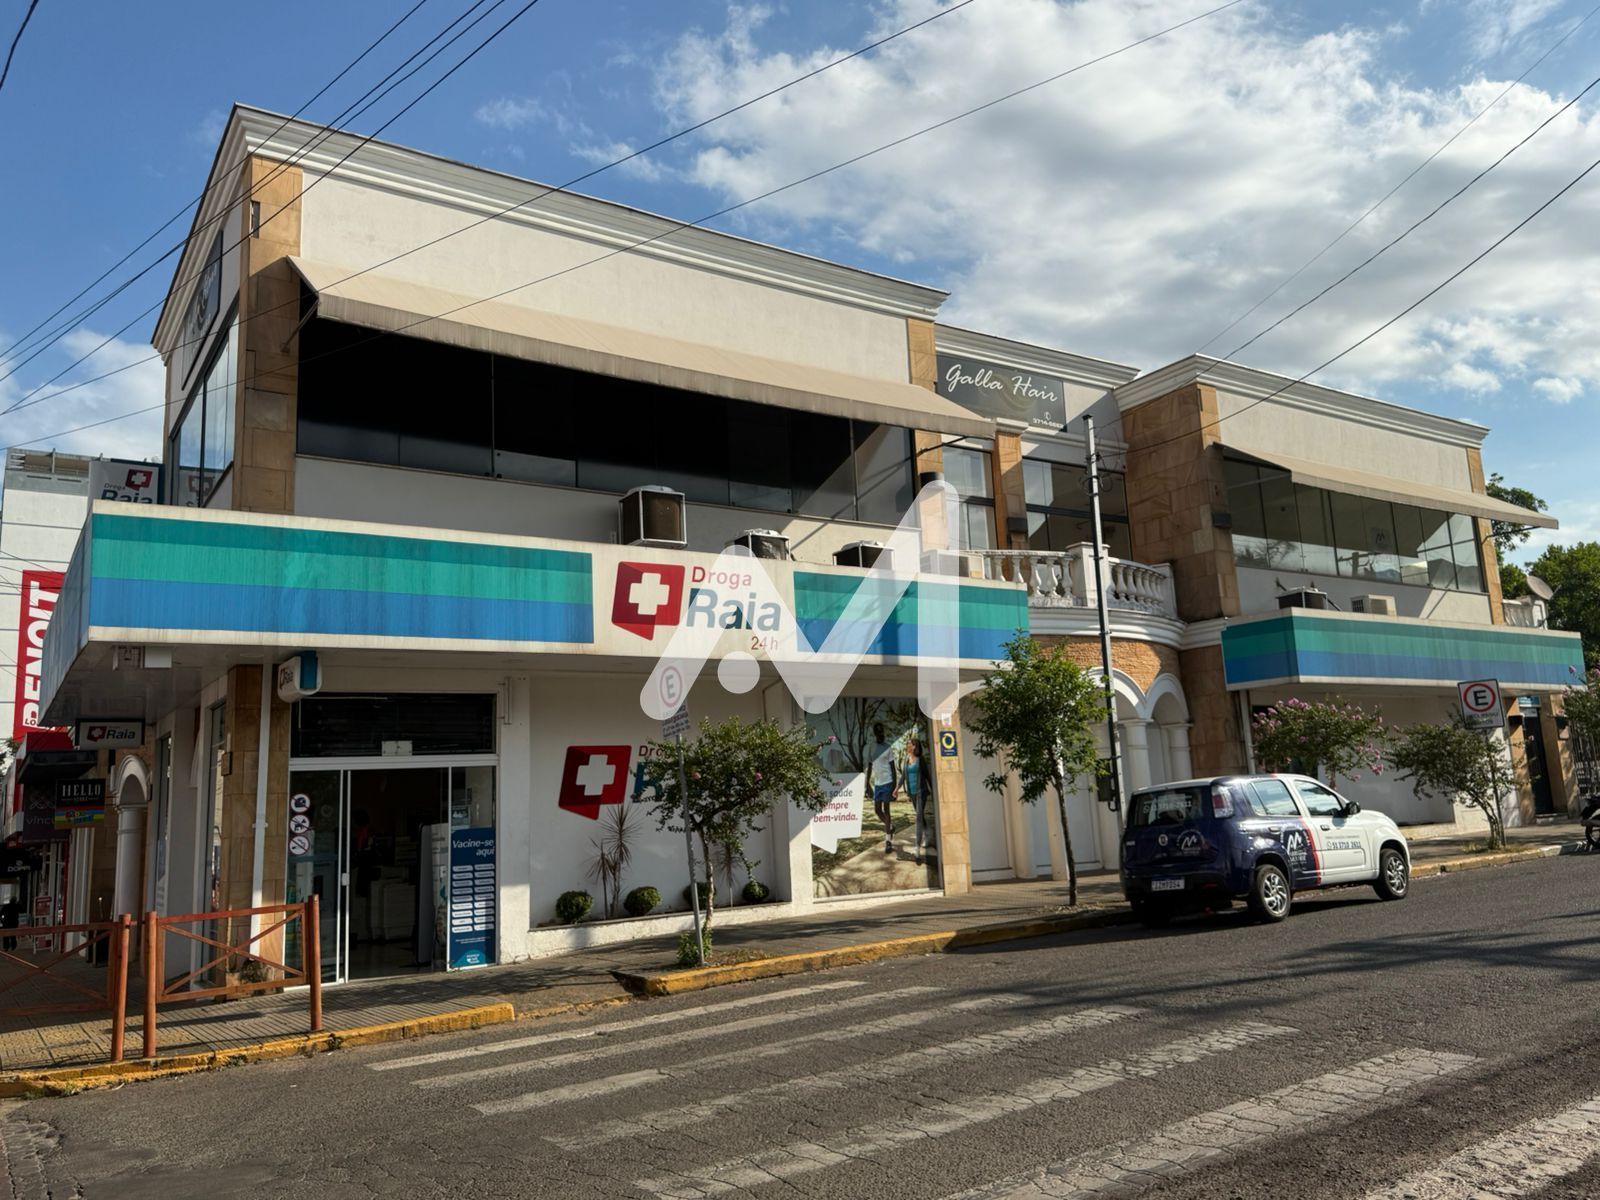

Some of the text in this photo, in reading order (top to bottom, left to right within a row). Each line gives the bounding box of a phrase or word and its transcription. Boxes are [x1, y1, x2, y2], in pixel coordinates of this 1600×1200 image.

[945, 364, 1057, 402] Galla Hair
[692, 566, 752, 590] Droga
[686, 588, 782, 632] Raia
[665, 674, 676, 699] E
[1473, 690, 1489, 706] E
[106, 729, 136, 740] Raia
[62, 783, 101, 797] HELLO
[822, 801, 849, 811] empre
[813, 812, 859, 823] bem-vinda.
[452, 839, 494, 849] Vacine-se
[476, 846, 495, 857] aqui
